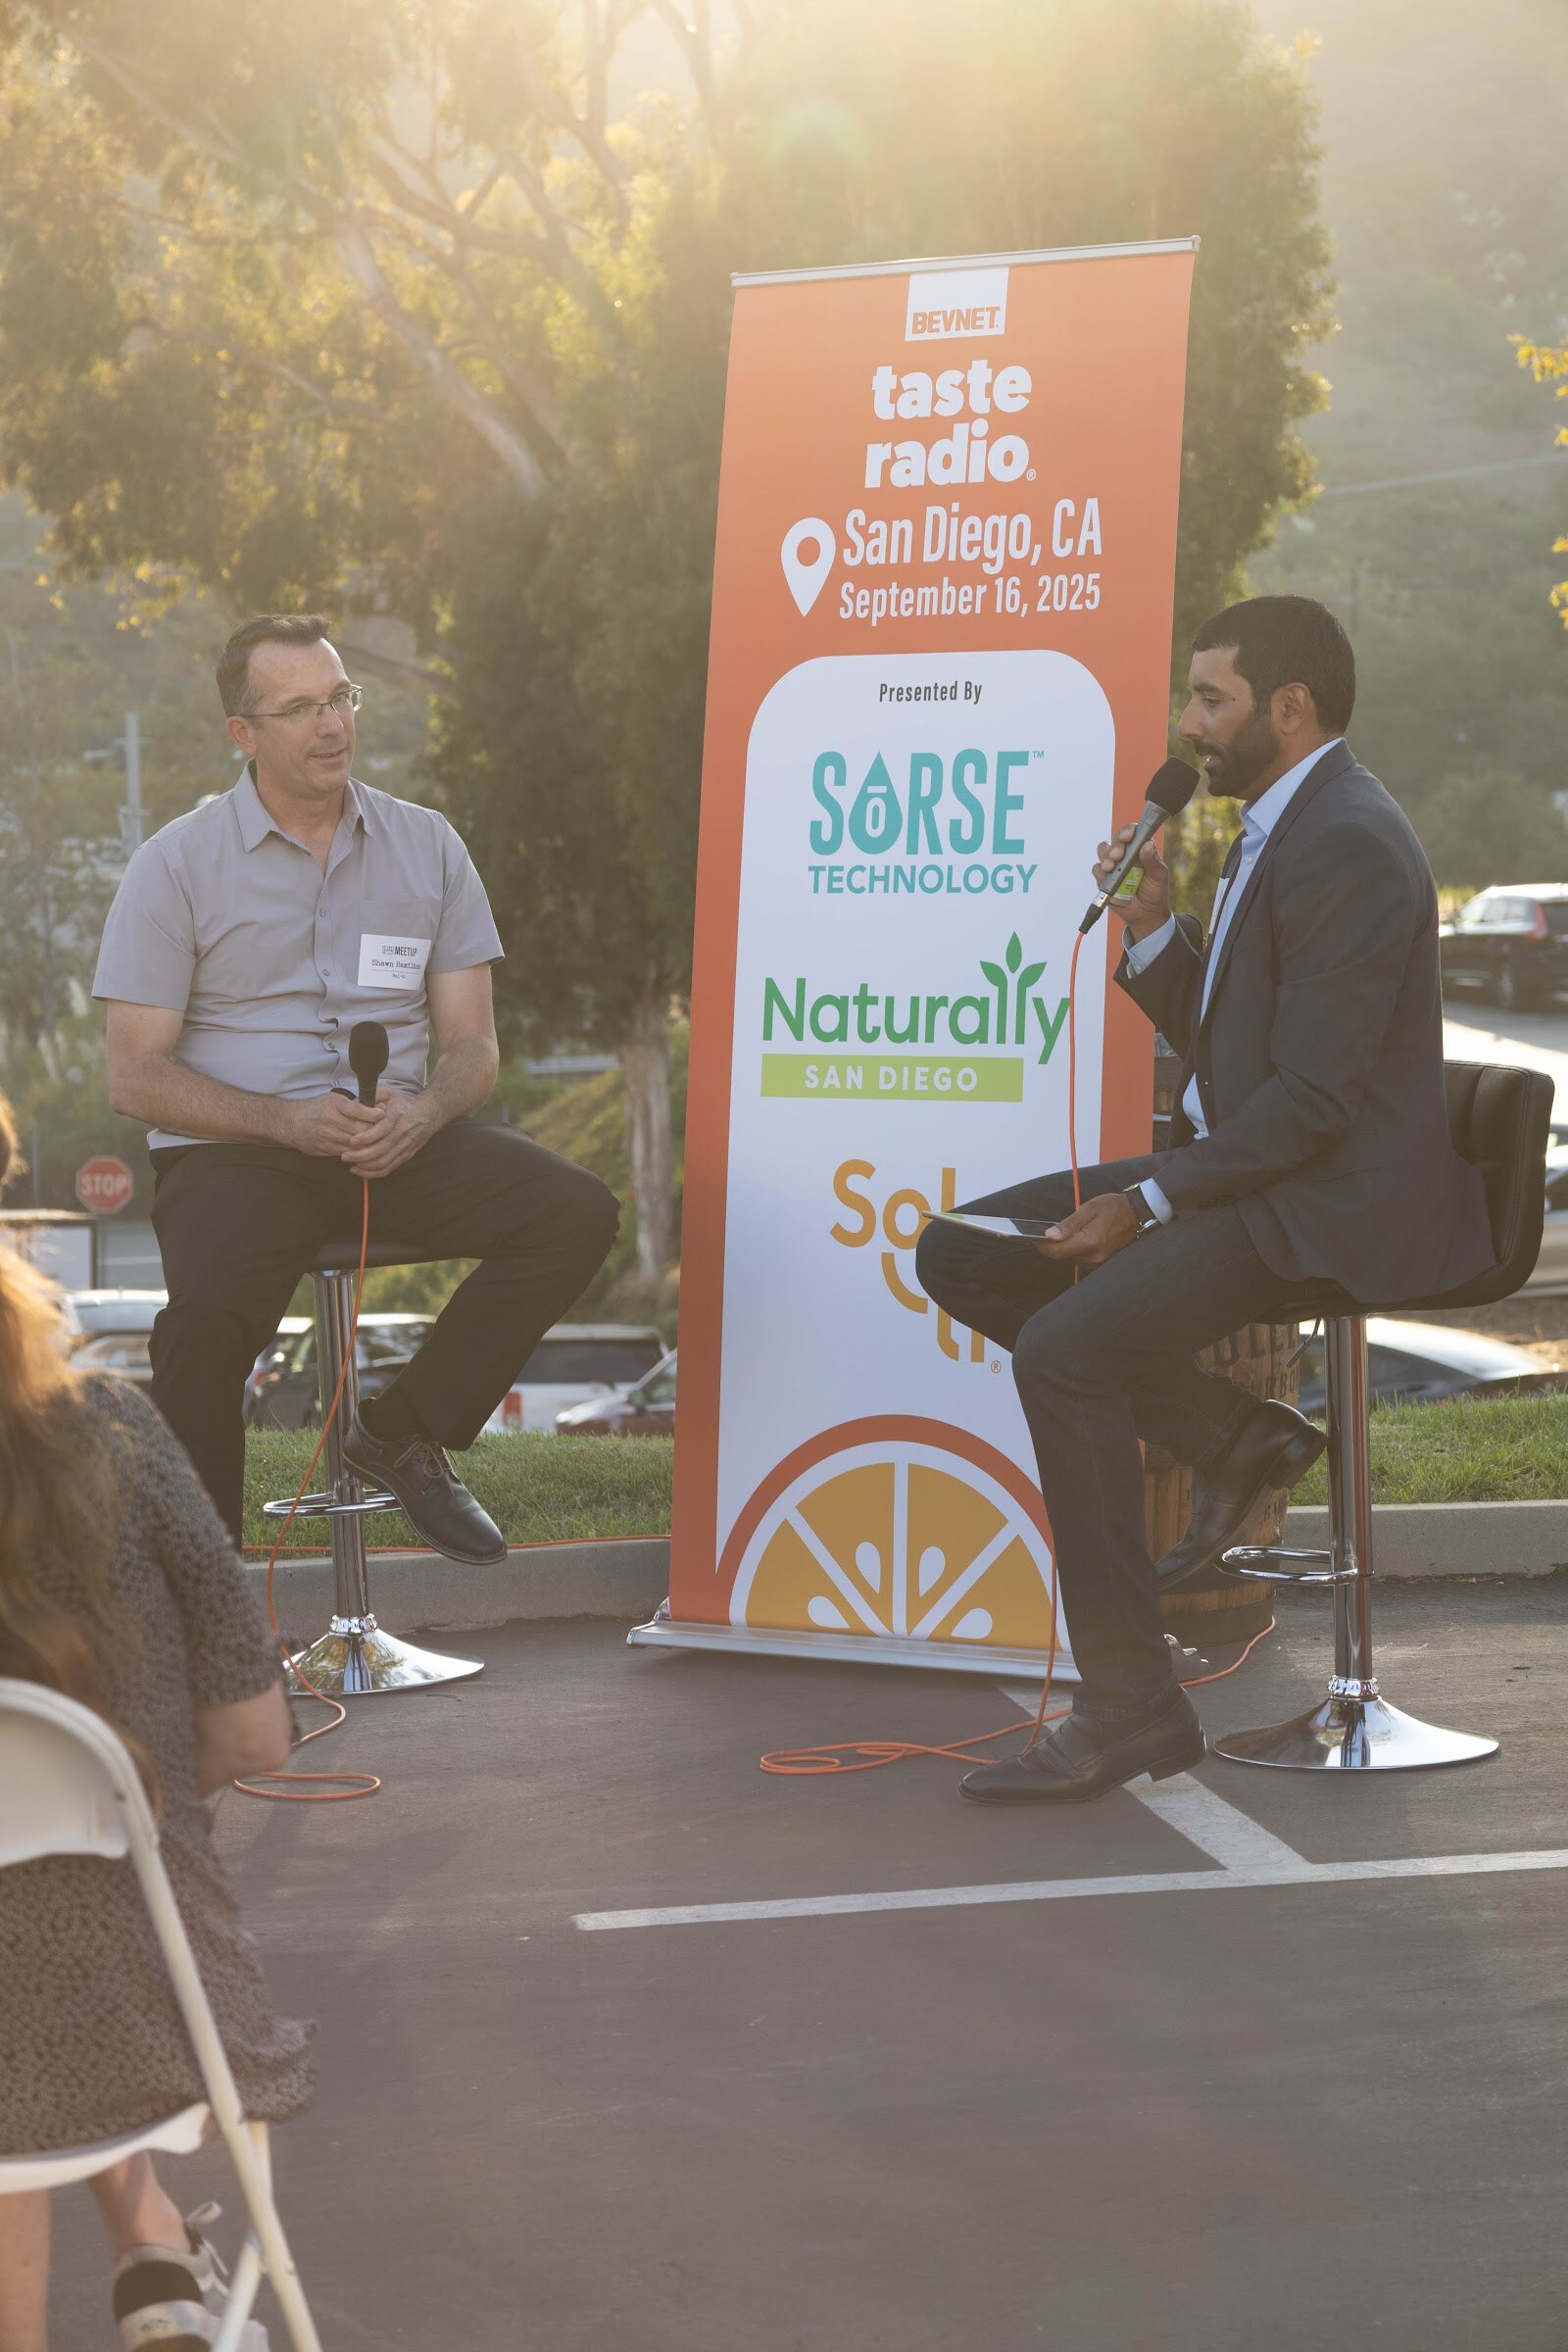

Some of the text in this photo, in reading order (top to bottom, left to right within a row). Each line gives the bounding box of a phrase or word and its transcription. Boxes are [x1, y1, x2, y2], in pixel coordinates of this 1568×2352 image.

[912, 307, 1001, 335] BEVNET
[871, 359, 1033, 421] taste
[843, 497, 1103, 575] San Diego, CA
[839, 572, 1102, 627] September 16, 2025
[879, 680, 983, 705] Presented By
[808, 863, 1039, 895] TECHNOLOGY
[394, 946, 417, 956] MEETUP
[762, 930, 1071, 1065] Naturally
[805, 1064, 979, 1093] SAN DIEGO
[81, 1173, 126, 1197] STOP
